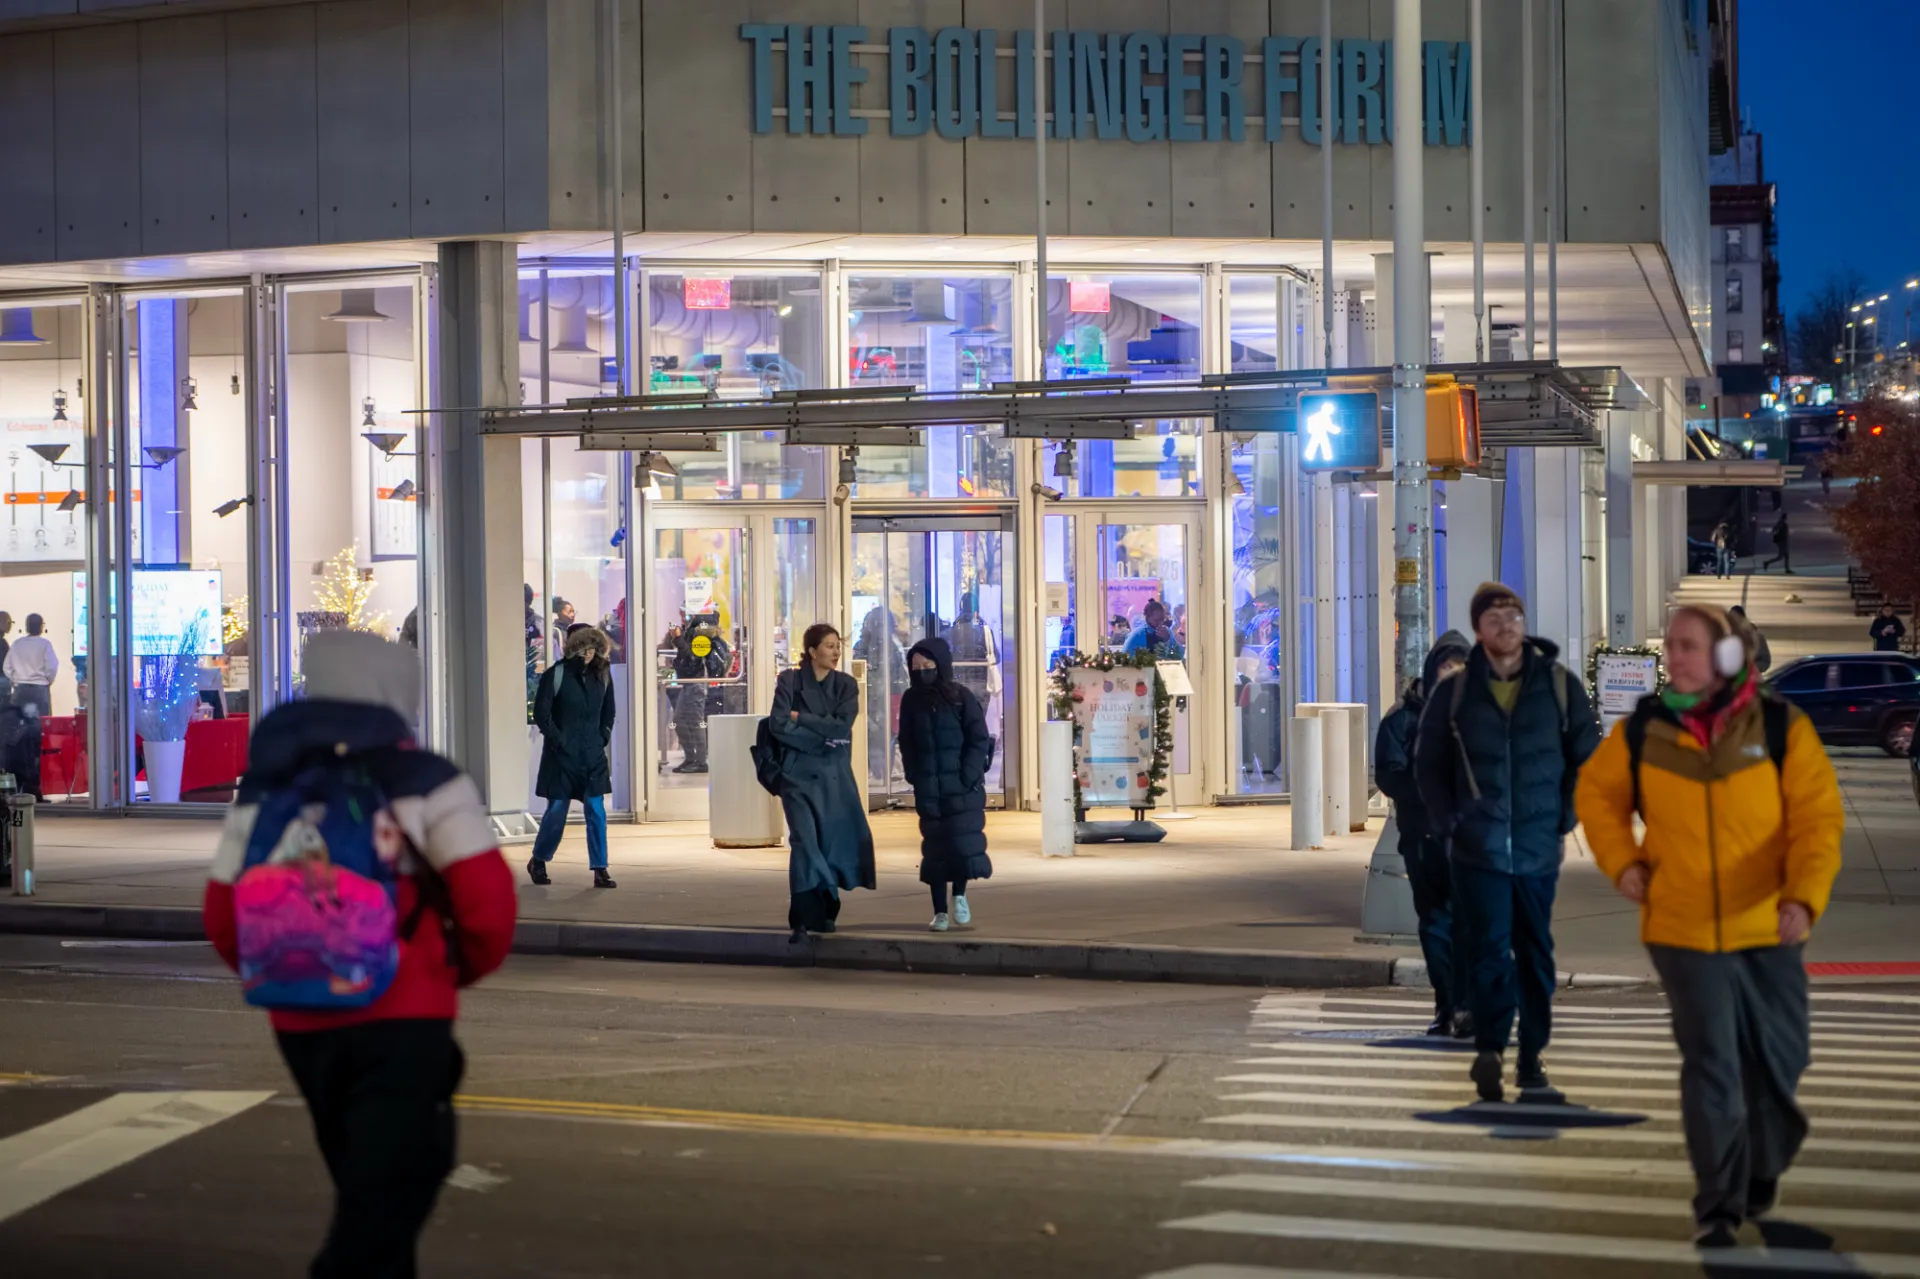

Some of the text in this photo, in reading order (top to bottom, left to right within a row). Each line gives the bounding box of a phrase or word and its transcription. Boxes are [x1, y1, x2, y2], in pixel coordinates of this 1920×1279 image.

[739, 23, 1473, 146] THE BOLLINGER FORM
[1090, 703, 1133, 712] HOLIDAY
